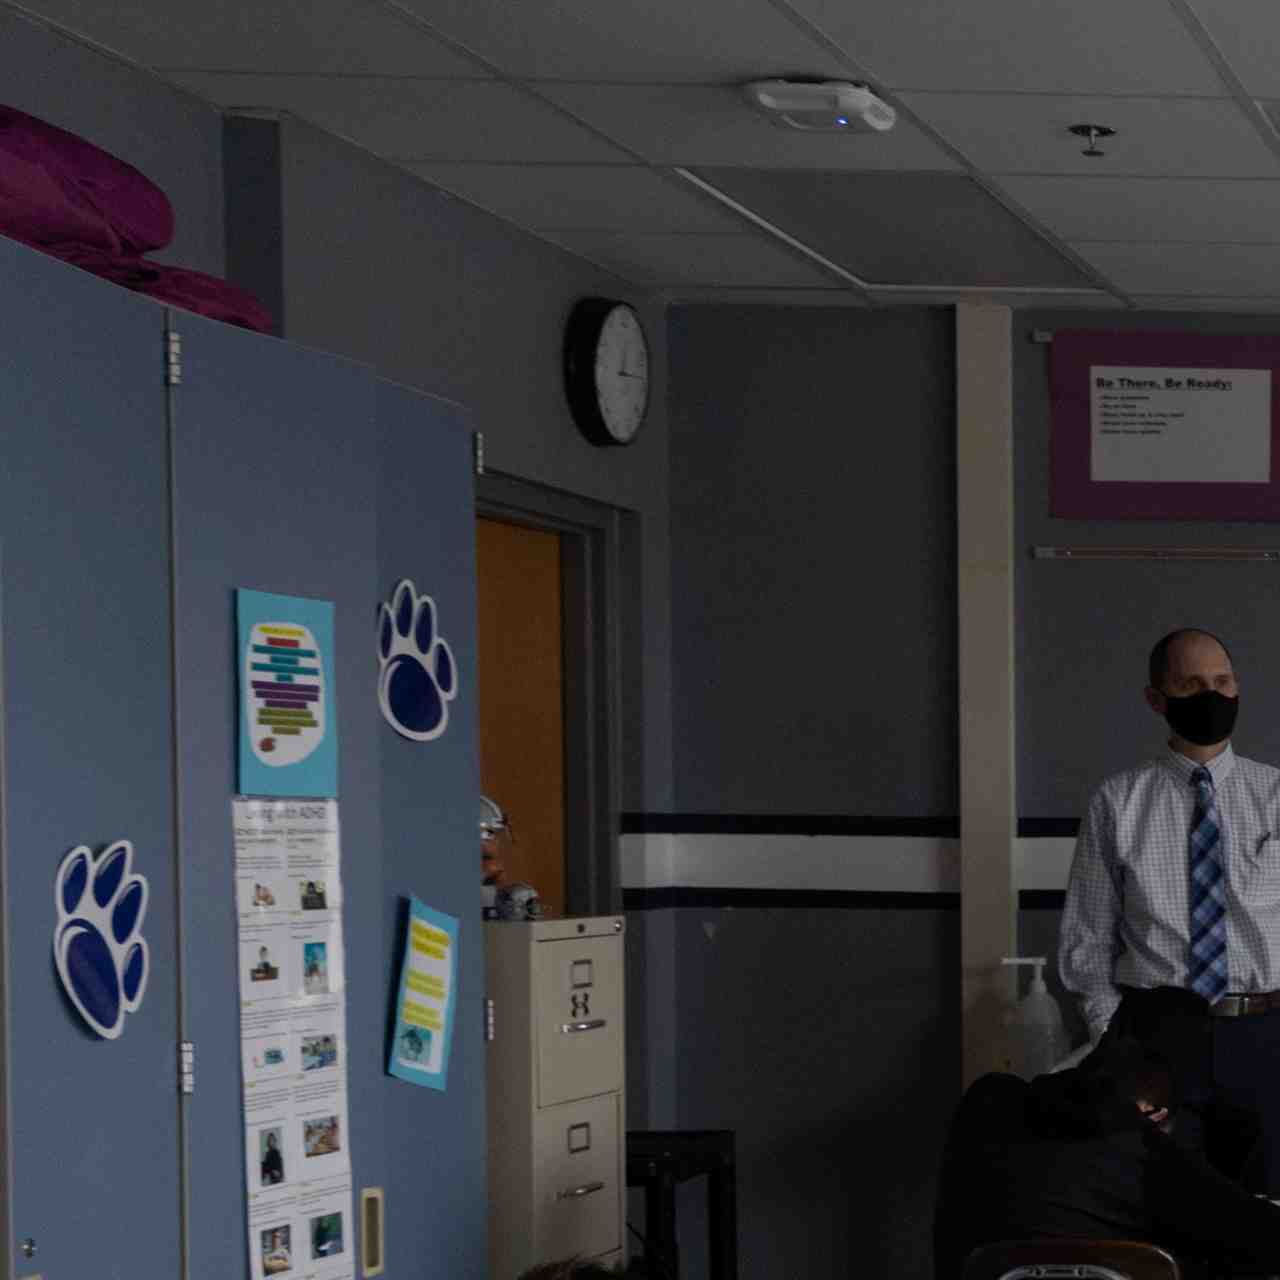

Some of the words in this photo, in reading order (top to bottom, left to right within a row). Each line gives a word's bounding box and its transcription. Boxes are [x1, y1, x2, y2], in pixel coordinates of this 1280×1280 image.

[1096, 378, 1114, 388] Be
[1119, 378, 1161, 390] There,
[1165, 378, 1182, 389] Be
[1187, 379, 1232, 391] Ready:
